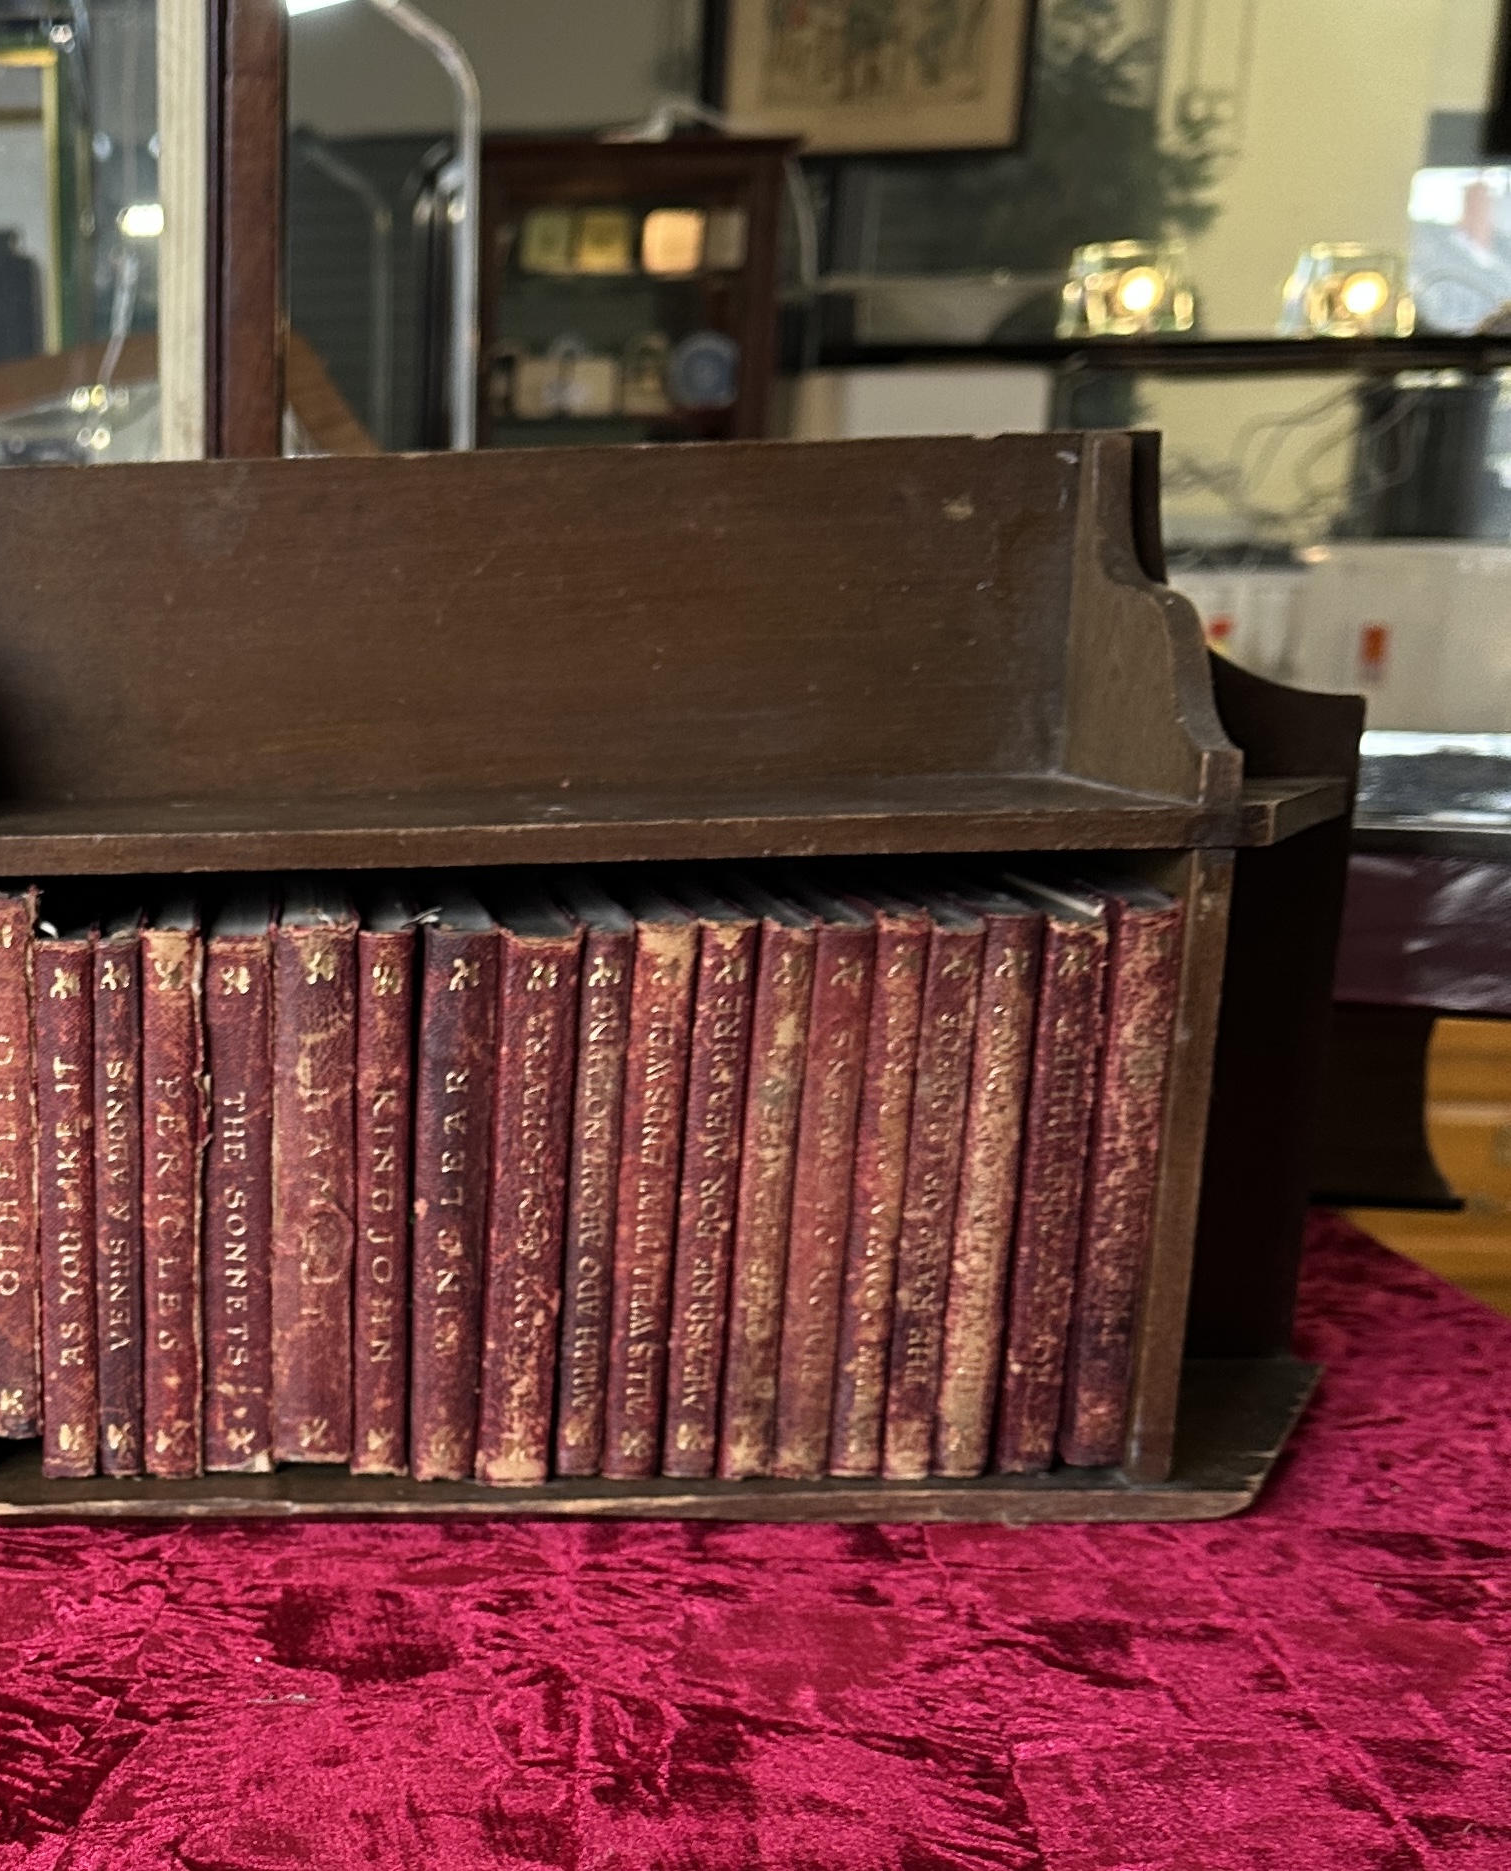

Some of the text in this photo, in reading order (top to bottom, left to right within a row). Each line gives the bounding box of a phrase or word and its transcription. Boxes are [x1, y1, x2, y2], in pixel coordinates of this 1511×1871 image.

[640, 1087, 672, 1168] ENDS
[644, 1005, 675, 1083] WELL
[52, 1055, 85, 1367] AS YOU LIKE IT
[104, 1060, 133, 1352] VENUS & ADONIS
[155, 1075, 183, 1351] PERICLES
[222, 1091, 251, 1366] THE SONNETS
[299, 1089, 332, 1318] HAMT
[365, 1089, 398, 1363] KING JOHN
[433, 1066, 471, 1359] KING LEAR
[575, 1254, 602, 1318] ADO
[578, 1148, 610, 1249] ABOUT
[628, 1267, 659, 1339] WELL
[681, 996, 741, 1412] MEASURE FOR MEASURE
[571, 1325, 600, 1408] MUCH
